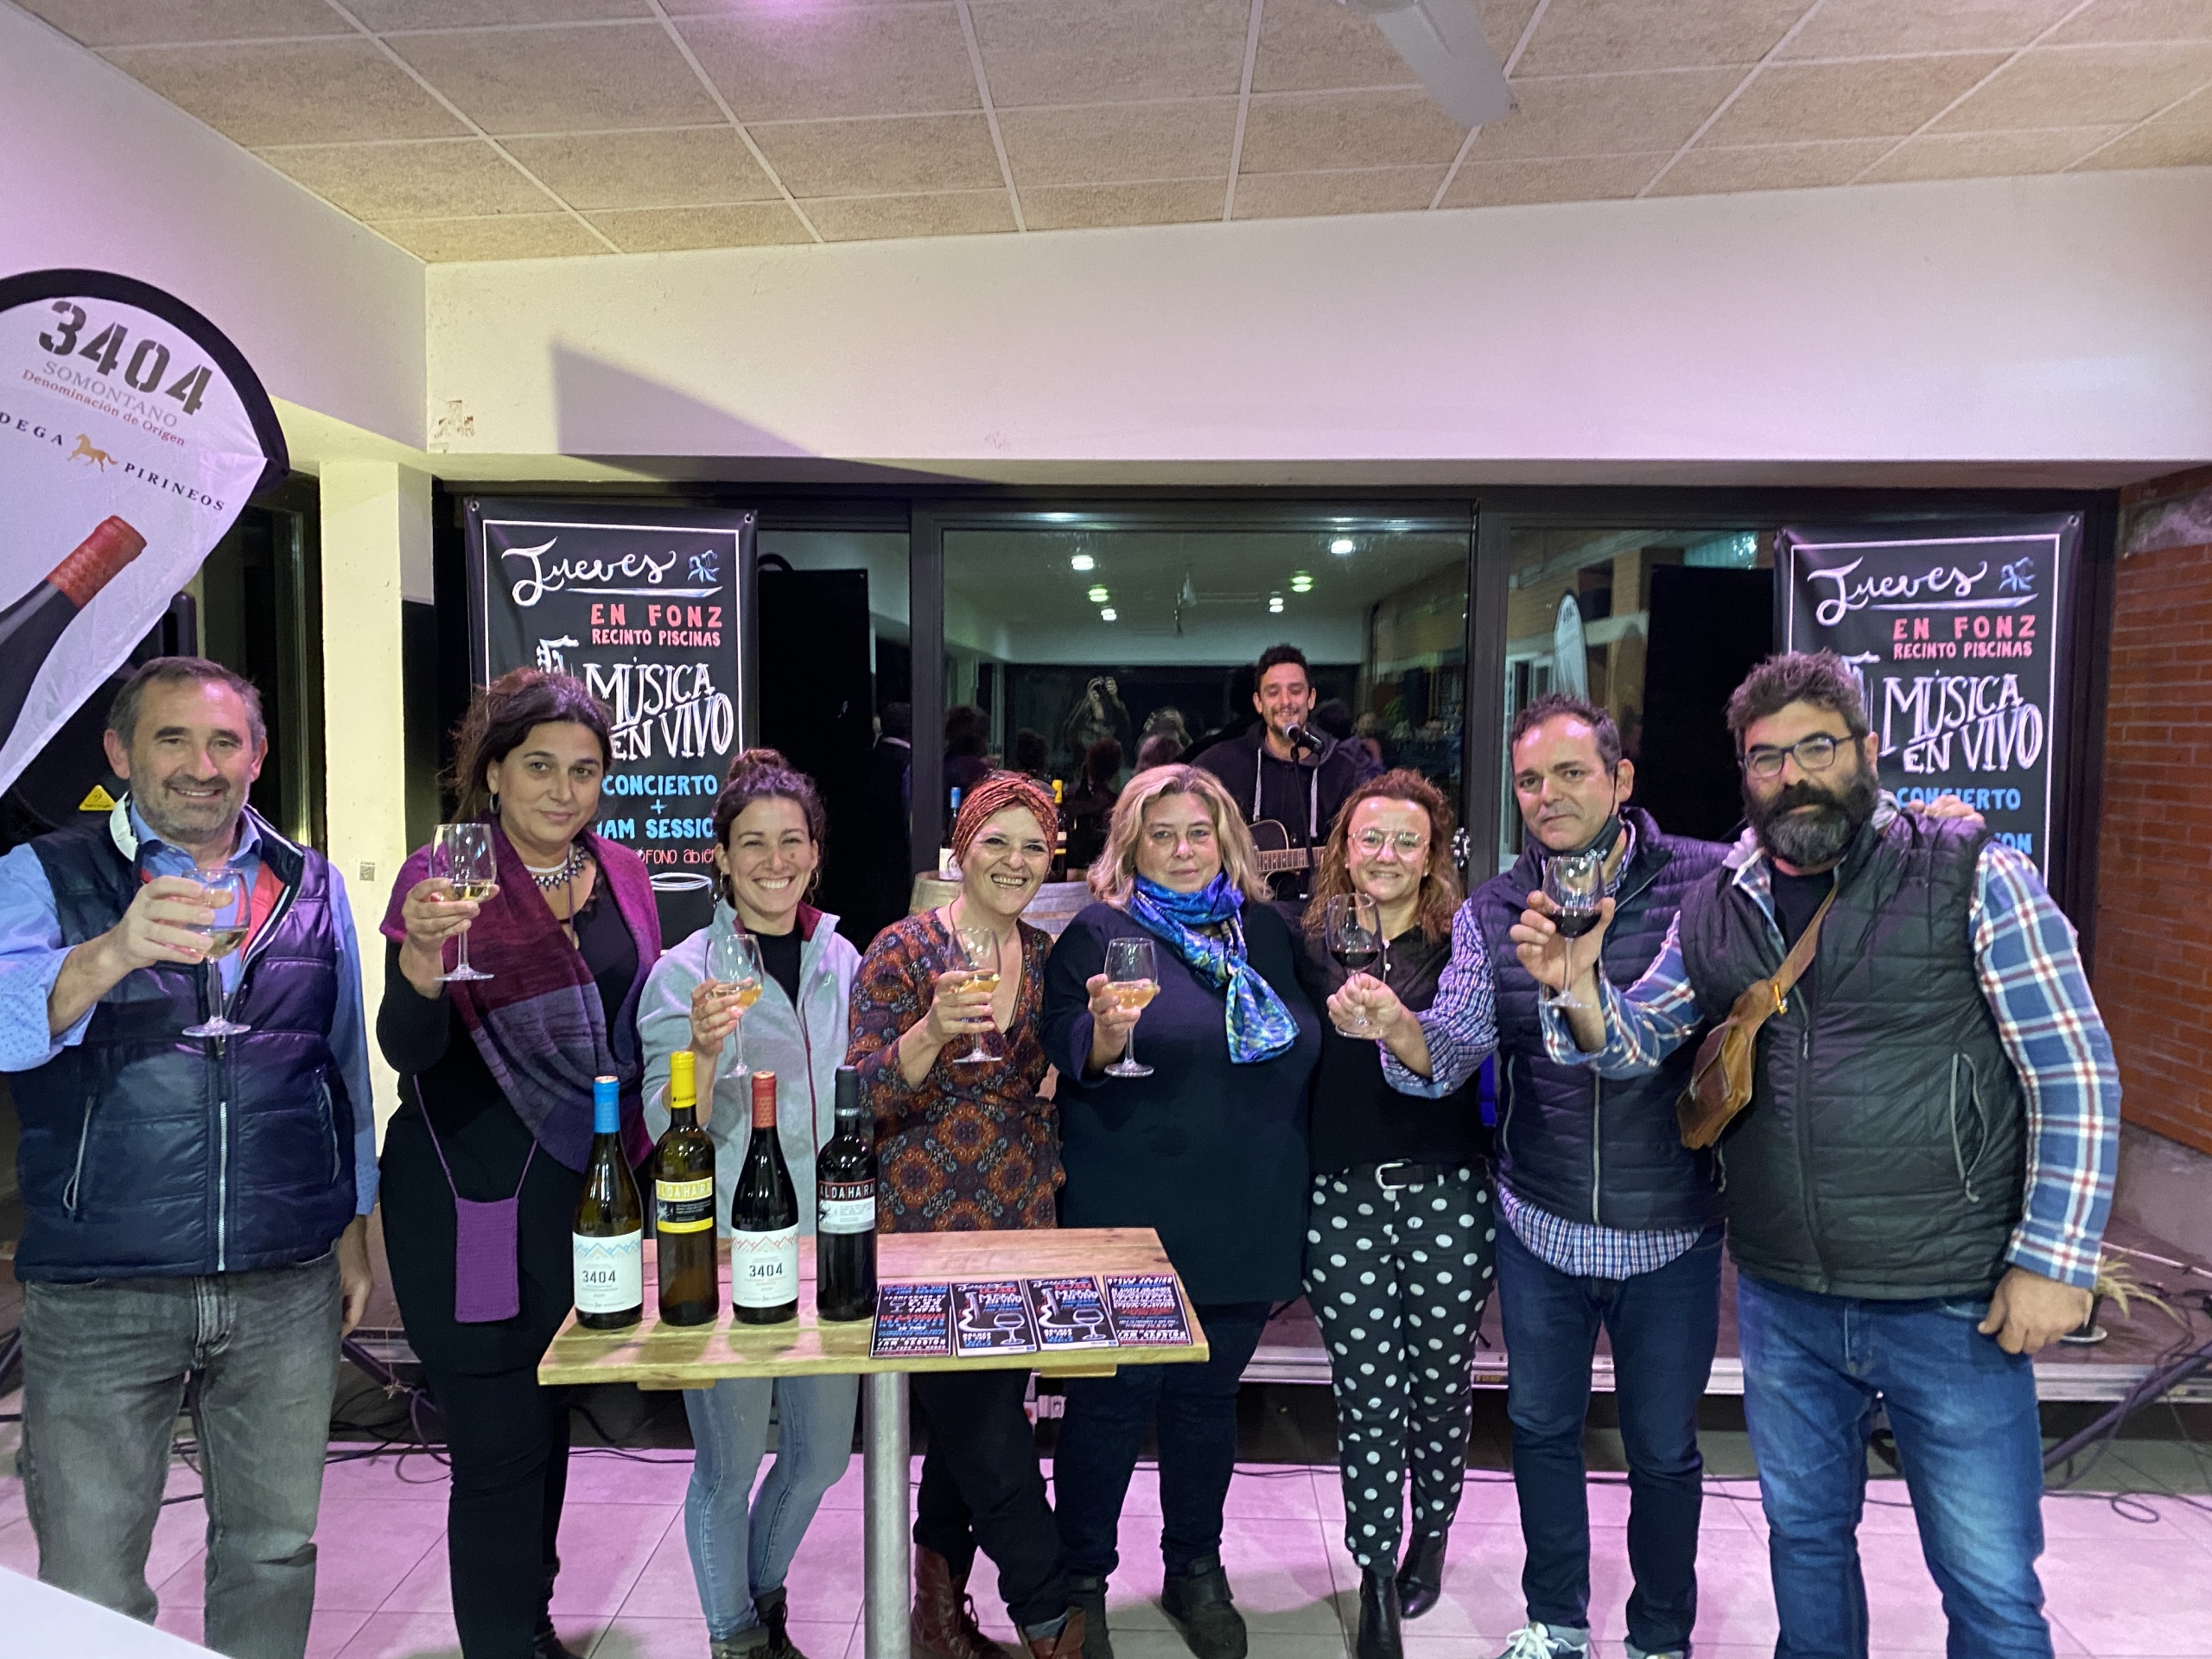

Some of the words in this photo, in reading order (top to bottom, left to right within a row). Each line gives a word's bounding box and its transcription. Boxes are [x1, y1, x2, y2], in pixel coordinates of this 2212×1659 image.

[39, 301, 213, 416] 3404
[22, 369, 120, 417] Denominación
[123, 412, 138, 424] de
[143, 420, 186, 447] Origen
[43, 360, 178, 428] SOMONTANO
[124, 461, 225, 512] PIRINEOS
[501, 537, 677, 607] Jueves
[1807, 556, 1987, 626] Jueves
[591, 604, 626, 626] EN
[648, 605, 722, 628] FONZ
[592, 628, 652, 646] RECINTO
[658, 630, 721, 647] PISCINAS
[1892, 618, 1929, 640] EN
[1954, 614, 2036, 639] FONZ
[1892, 641, 1957, 660] RECINTO
[1963, 640, 2032, 659] PISCINAS
[608, 719, 653, 761] EN
[658, 692, 734, 759] VIVO
[1903, 732, 1954, 774] EN
[1959, 703, 2043, 772] VIVO
[601, 774, 718, 796] CONCIERTO
[582, 1269, 616, 1283] 3404
[748, 1262, 783, 1278] 3404
